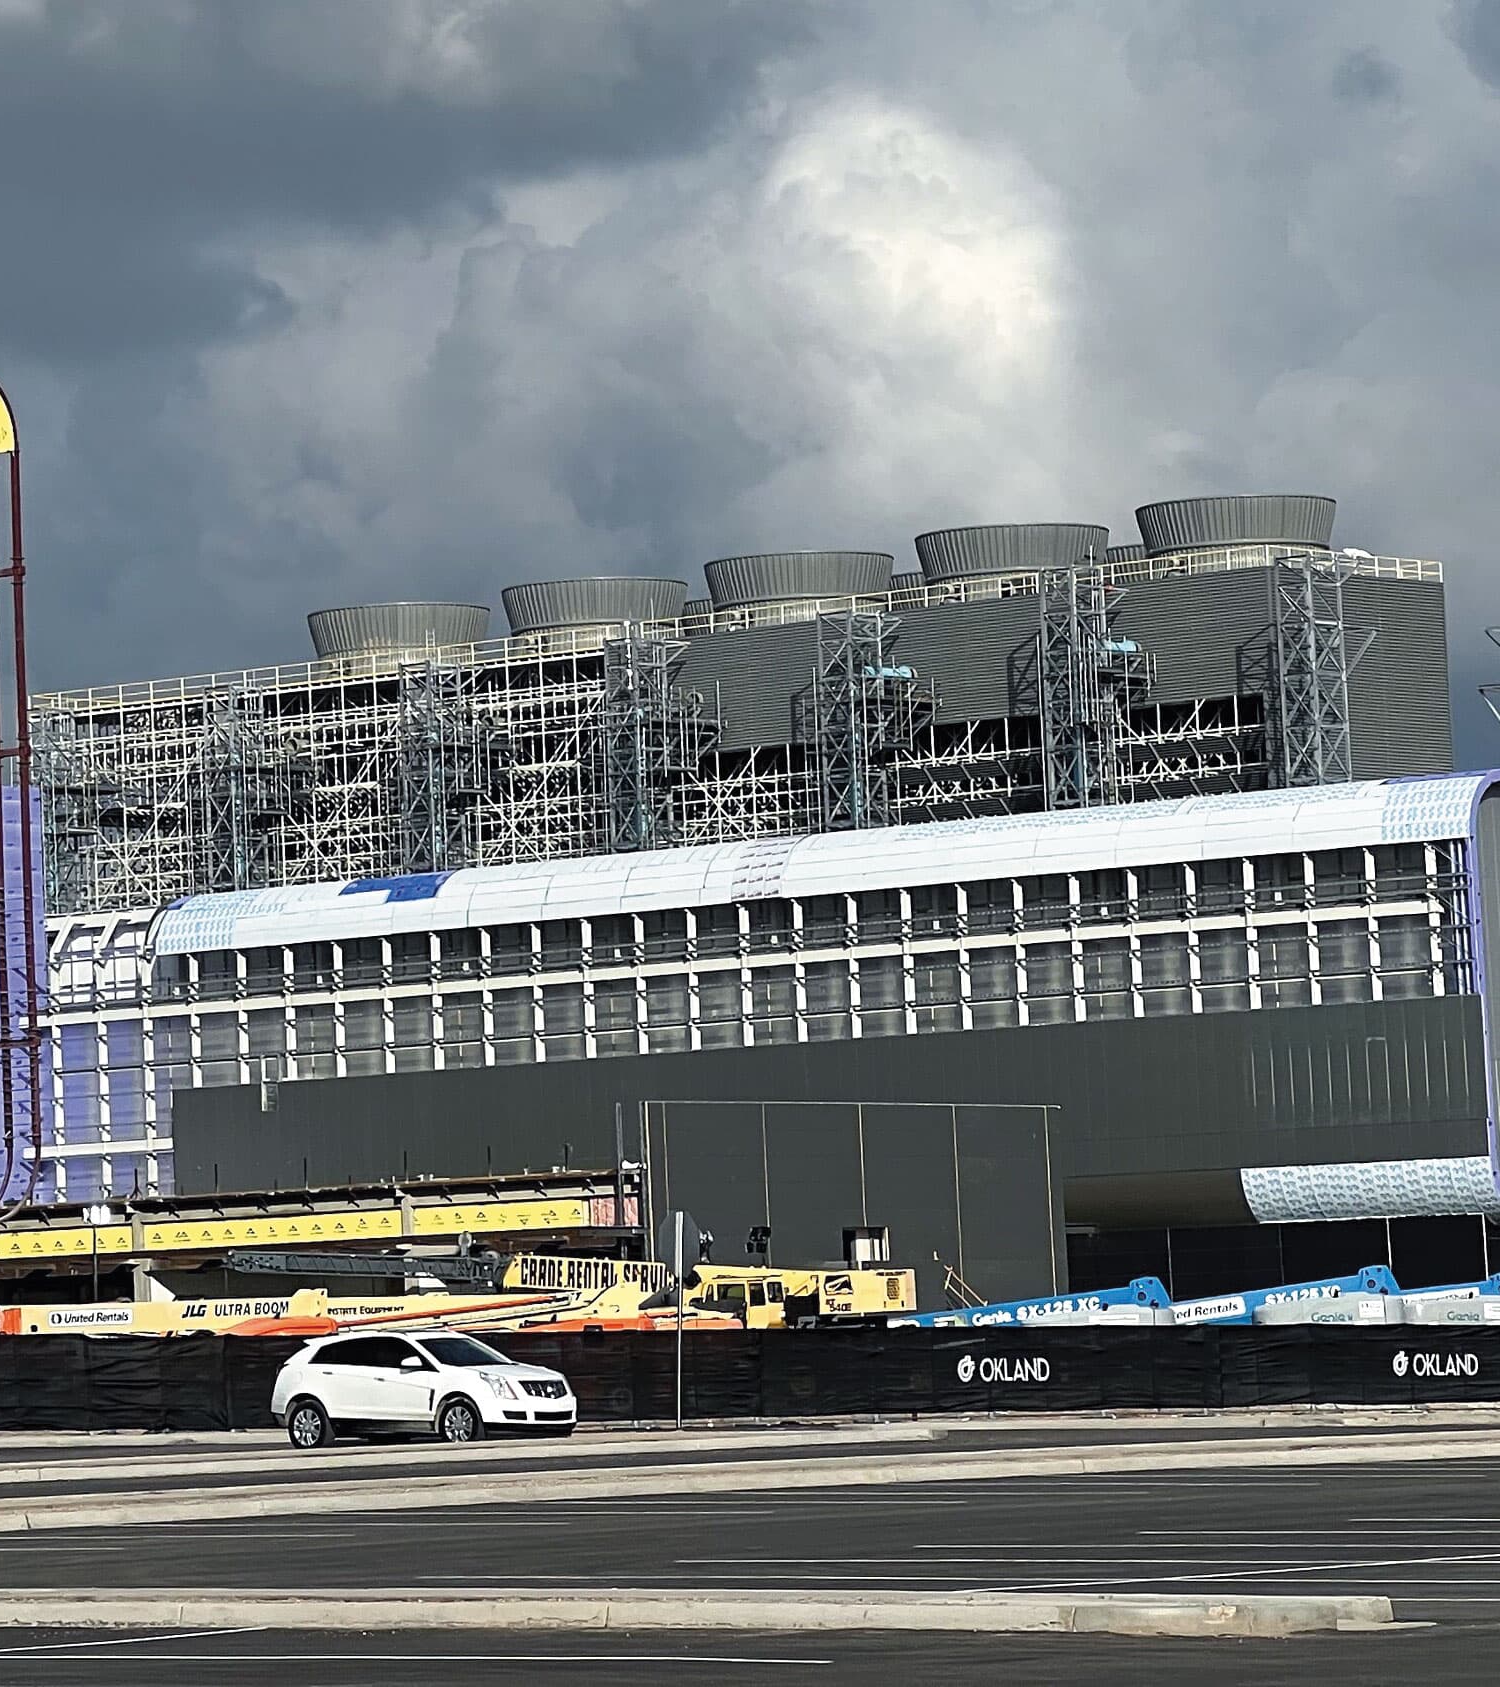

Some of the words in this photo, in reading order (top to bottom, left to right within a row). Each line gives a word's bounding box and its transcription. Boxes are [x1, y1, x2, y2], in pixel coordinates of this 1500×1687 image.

[182, 1304, 207, 1318] JLG
[214, 1303, 251, 1316] ULTRA
[254, 1301, 289, 1319] BOOM
[1077, 1296, 1100, 1311] XC
[1194, 1303, 1238, 1317] Rentals
[64, 1313, 94, 1323] United
[96, 1311, 129, 1322] Rentals
[979, 1357, 1050, 1383] OKLAND
[1413, 1353, 1479, 1377] OKLAND
